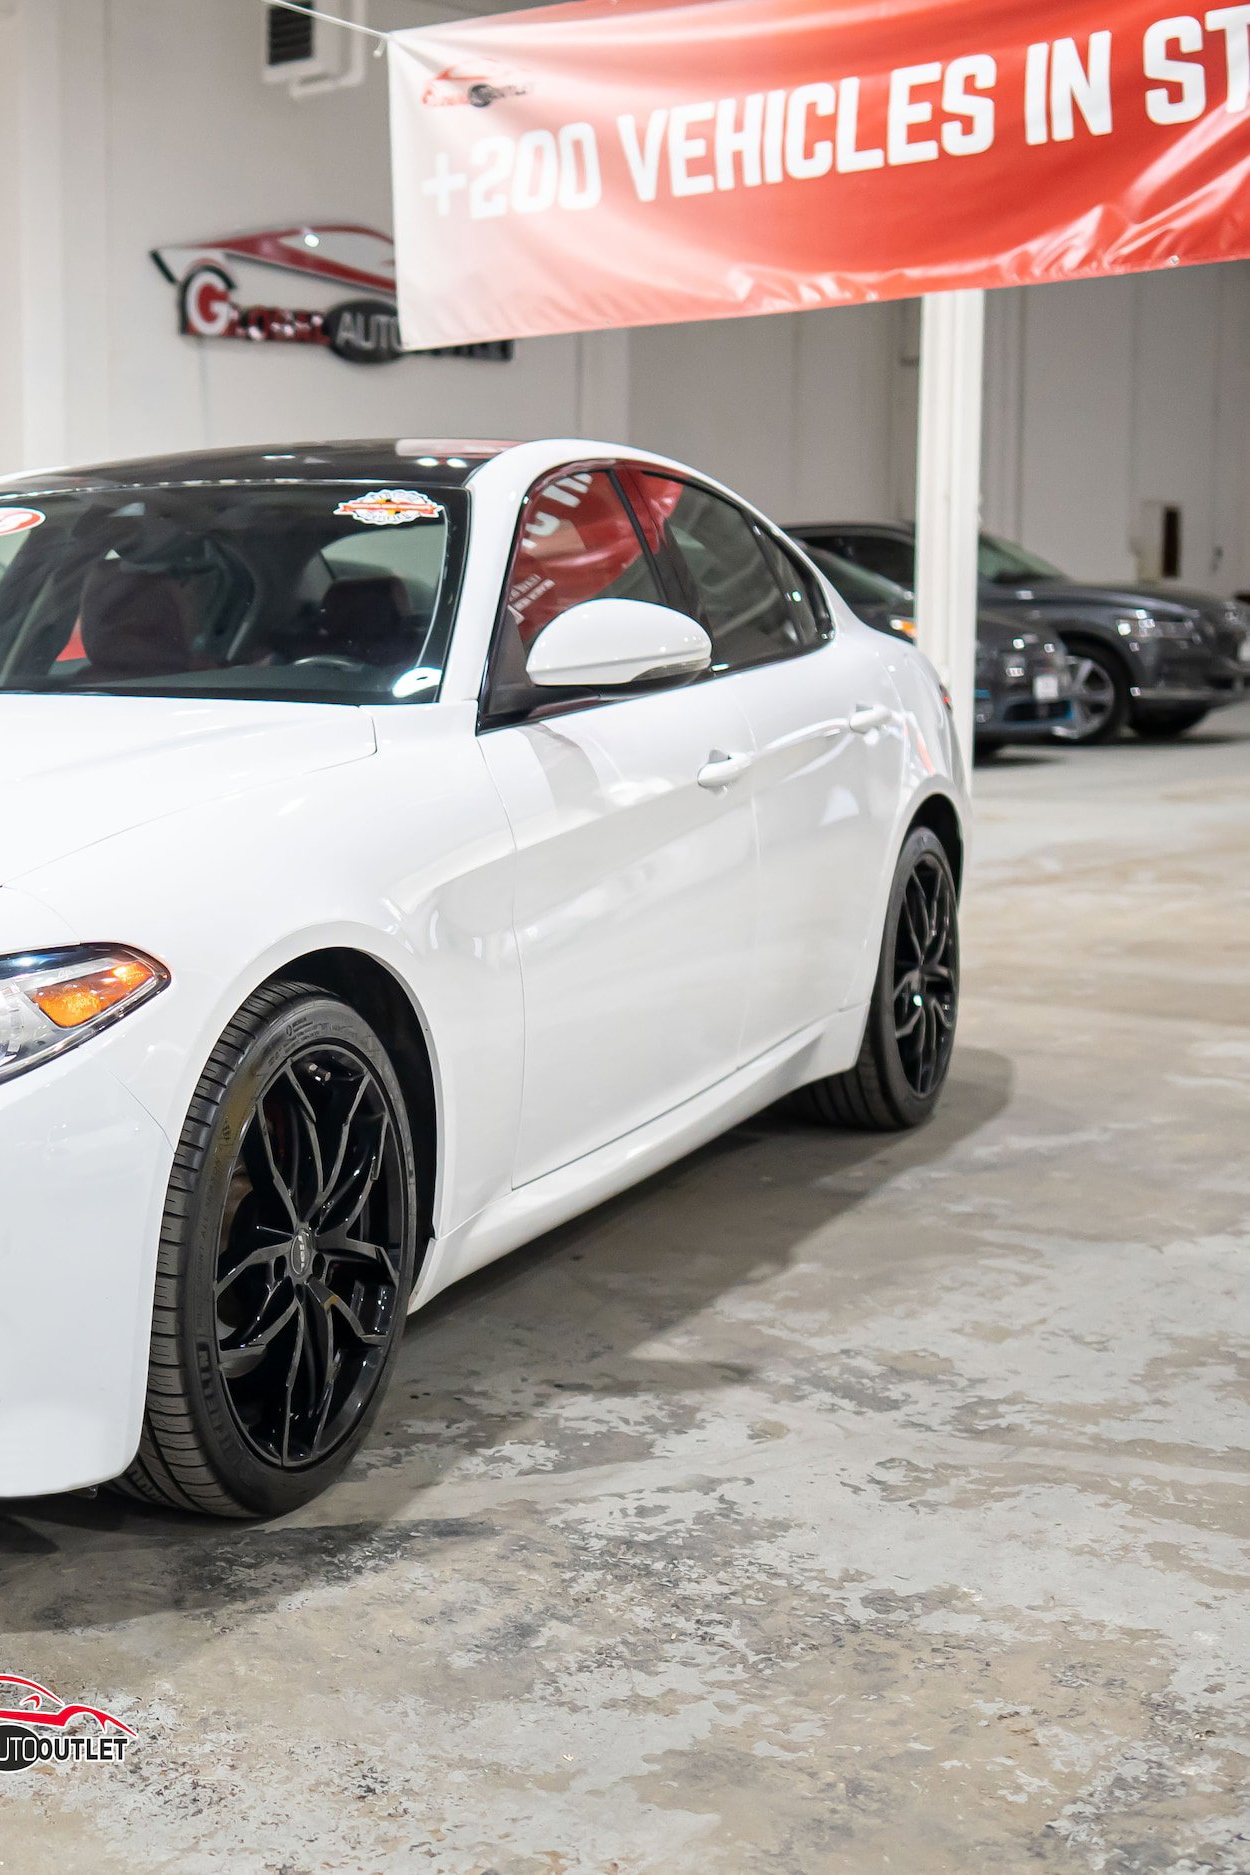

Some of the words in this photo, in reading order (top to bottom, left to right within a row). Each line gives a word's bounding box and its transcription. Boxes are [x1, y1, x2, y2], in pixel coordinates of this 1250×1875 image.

[421, 122, 602, 219] +200
[616, 53, 997, 202] VEHICLES
[1024, 29, 1112, 146] IN
